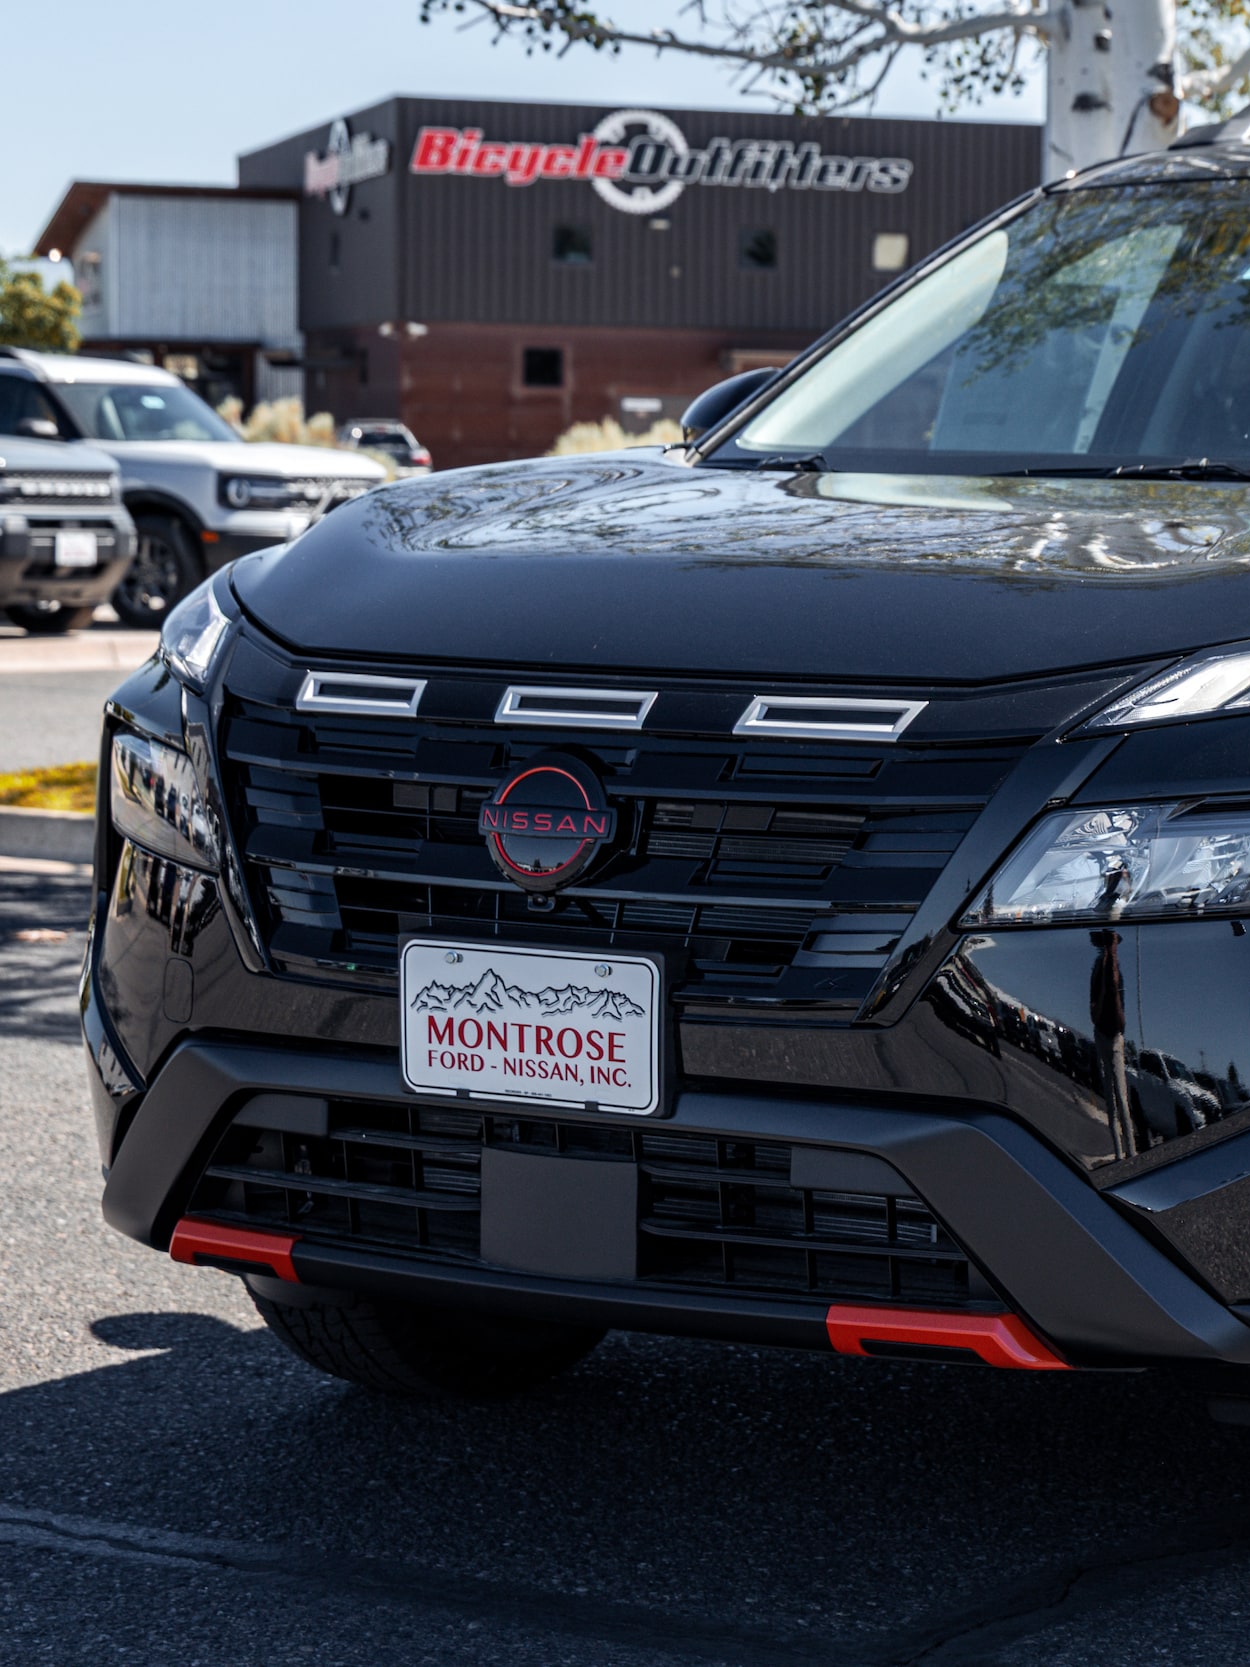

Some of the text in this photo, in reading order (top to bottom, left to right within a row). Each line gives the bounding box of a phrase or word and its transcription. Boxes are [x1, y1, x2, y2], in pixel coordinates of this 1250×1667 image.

[483, 808, 607, 834] NISSAN
[427, 1014, 627, 1063] MONTROSE
[428, 1049, 485, 1073] FORD
[503, 1056, 585, 1087] NISSAN,
[589, 1065, 632, 1088] INC.
